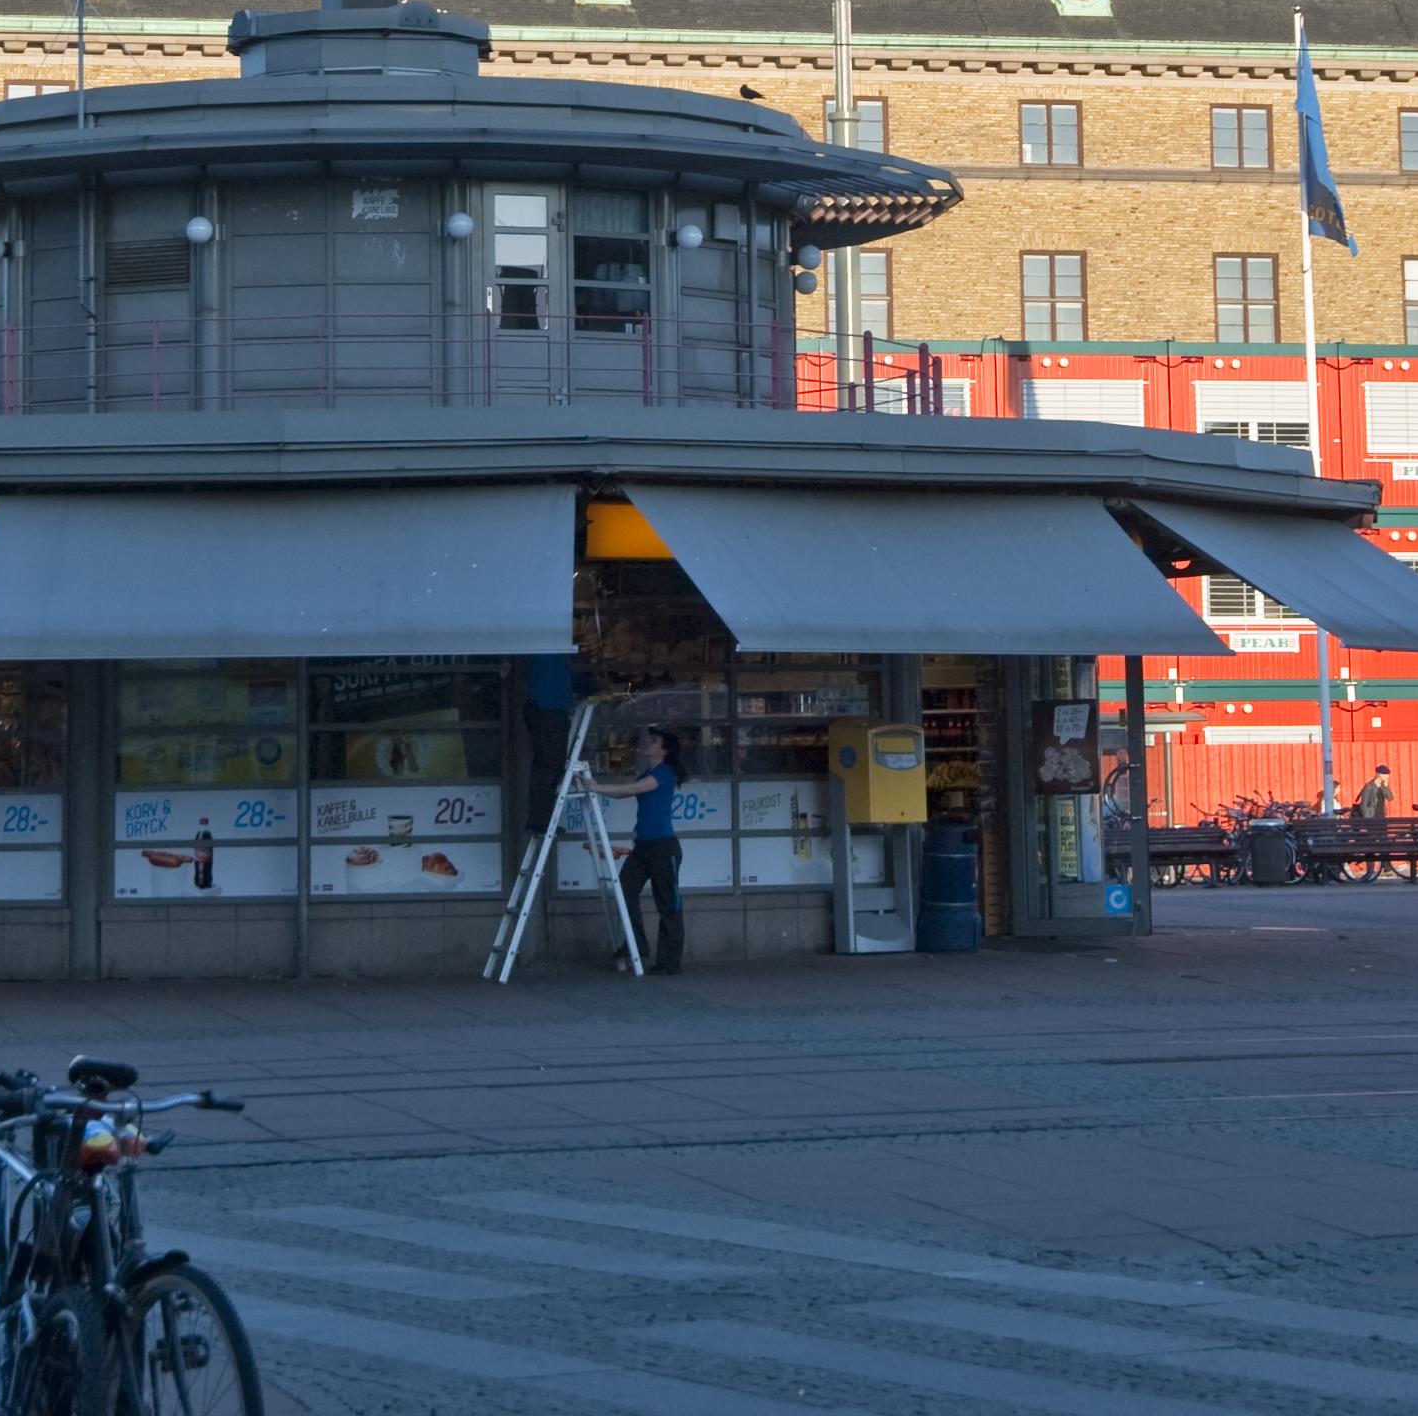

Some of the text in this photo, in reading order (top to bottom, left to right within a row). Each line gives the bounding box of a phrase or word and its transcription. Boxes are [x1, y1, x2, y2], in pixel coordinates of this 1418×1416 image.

[1240, 637, 1289, 648] PEAB
[125, 801, 159, 822] KORV
[234, 800, 285, 828] 28:-
[317, 800, 348, 816] KAFFE
[317, 807, 377, 829] KANELBULLE
[434, 797, 485, 824] 20:-
[3, 805, 48, 833] 28:-
[125, 818, 168, 838] DRYCK
